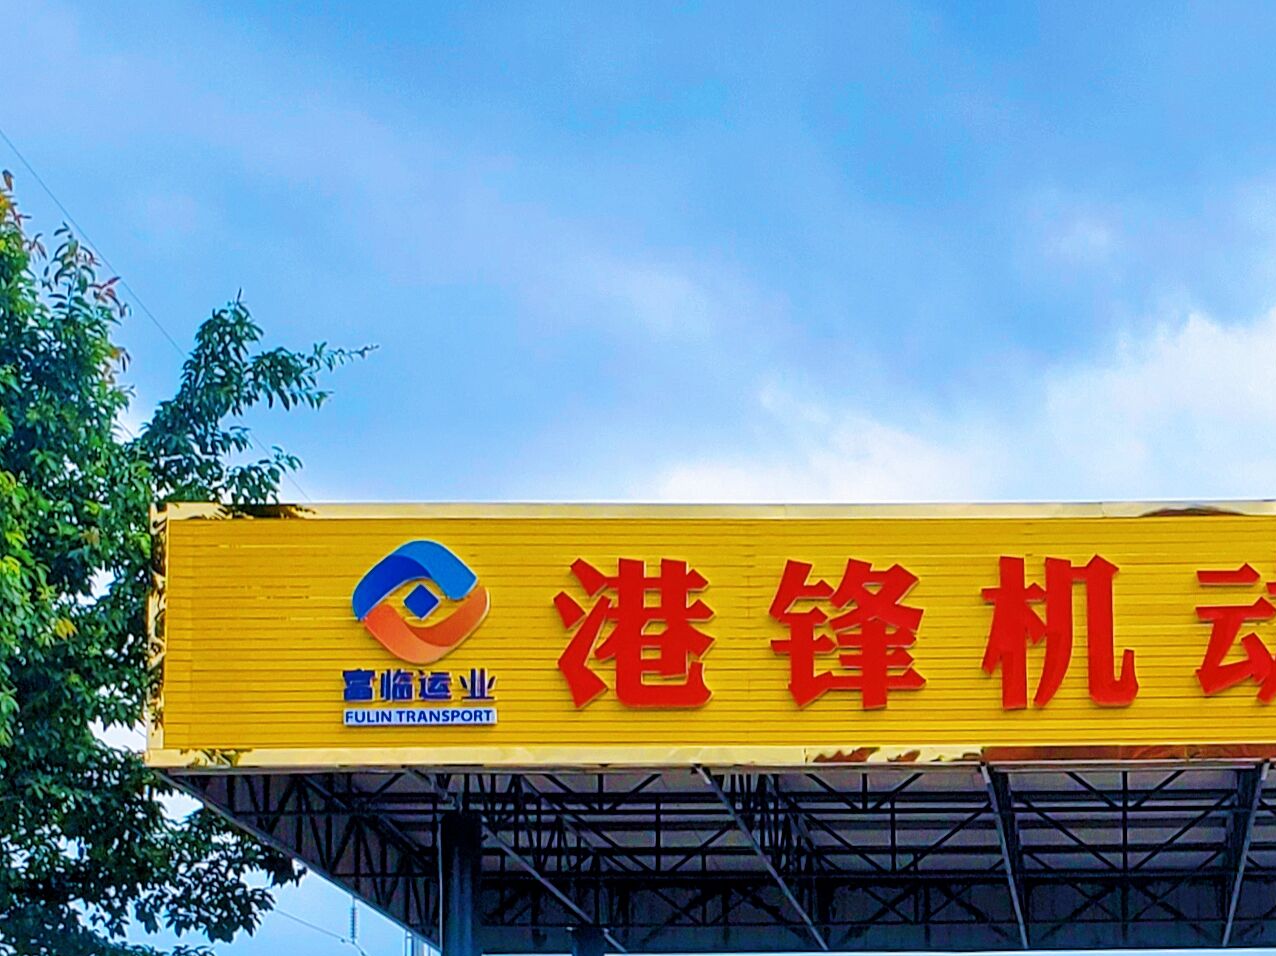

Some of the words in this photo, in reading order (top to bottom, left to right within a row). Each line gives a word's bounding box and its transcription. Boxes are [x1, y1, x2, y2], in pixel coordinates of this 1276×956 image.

[342, 668, 496, 701] 富临运业
[345, 711, 392, 723] FULIN
[396, 710, 492, 722] TRANSPORT
